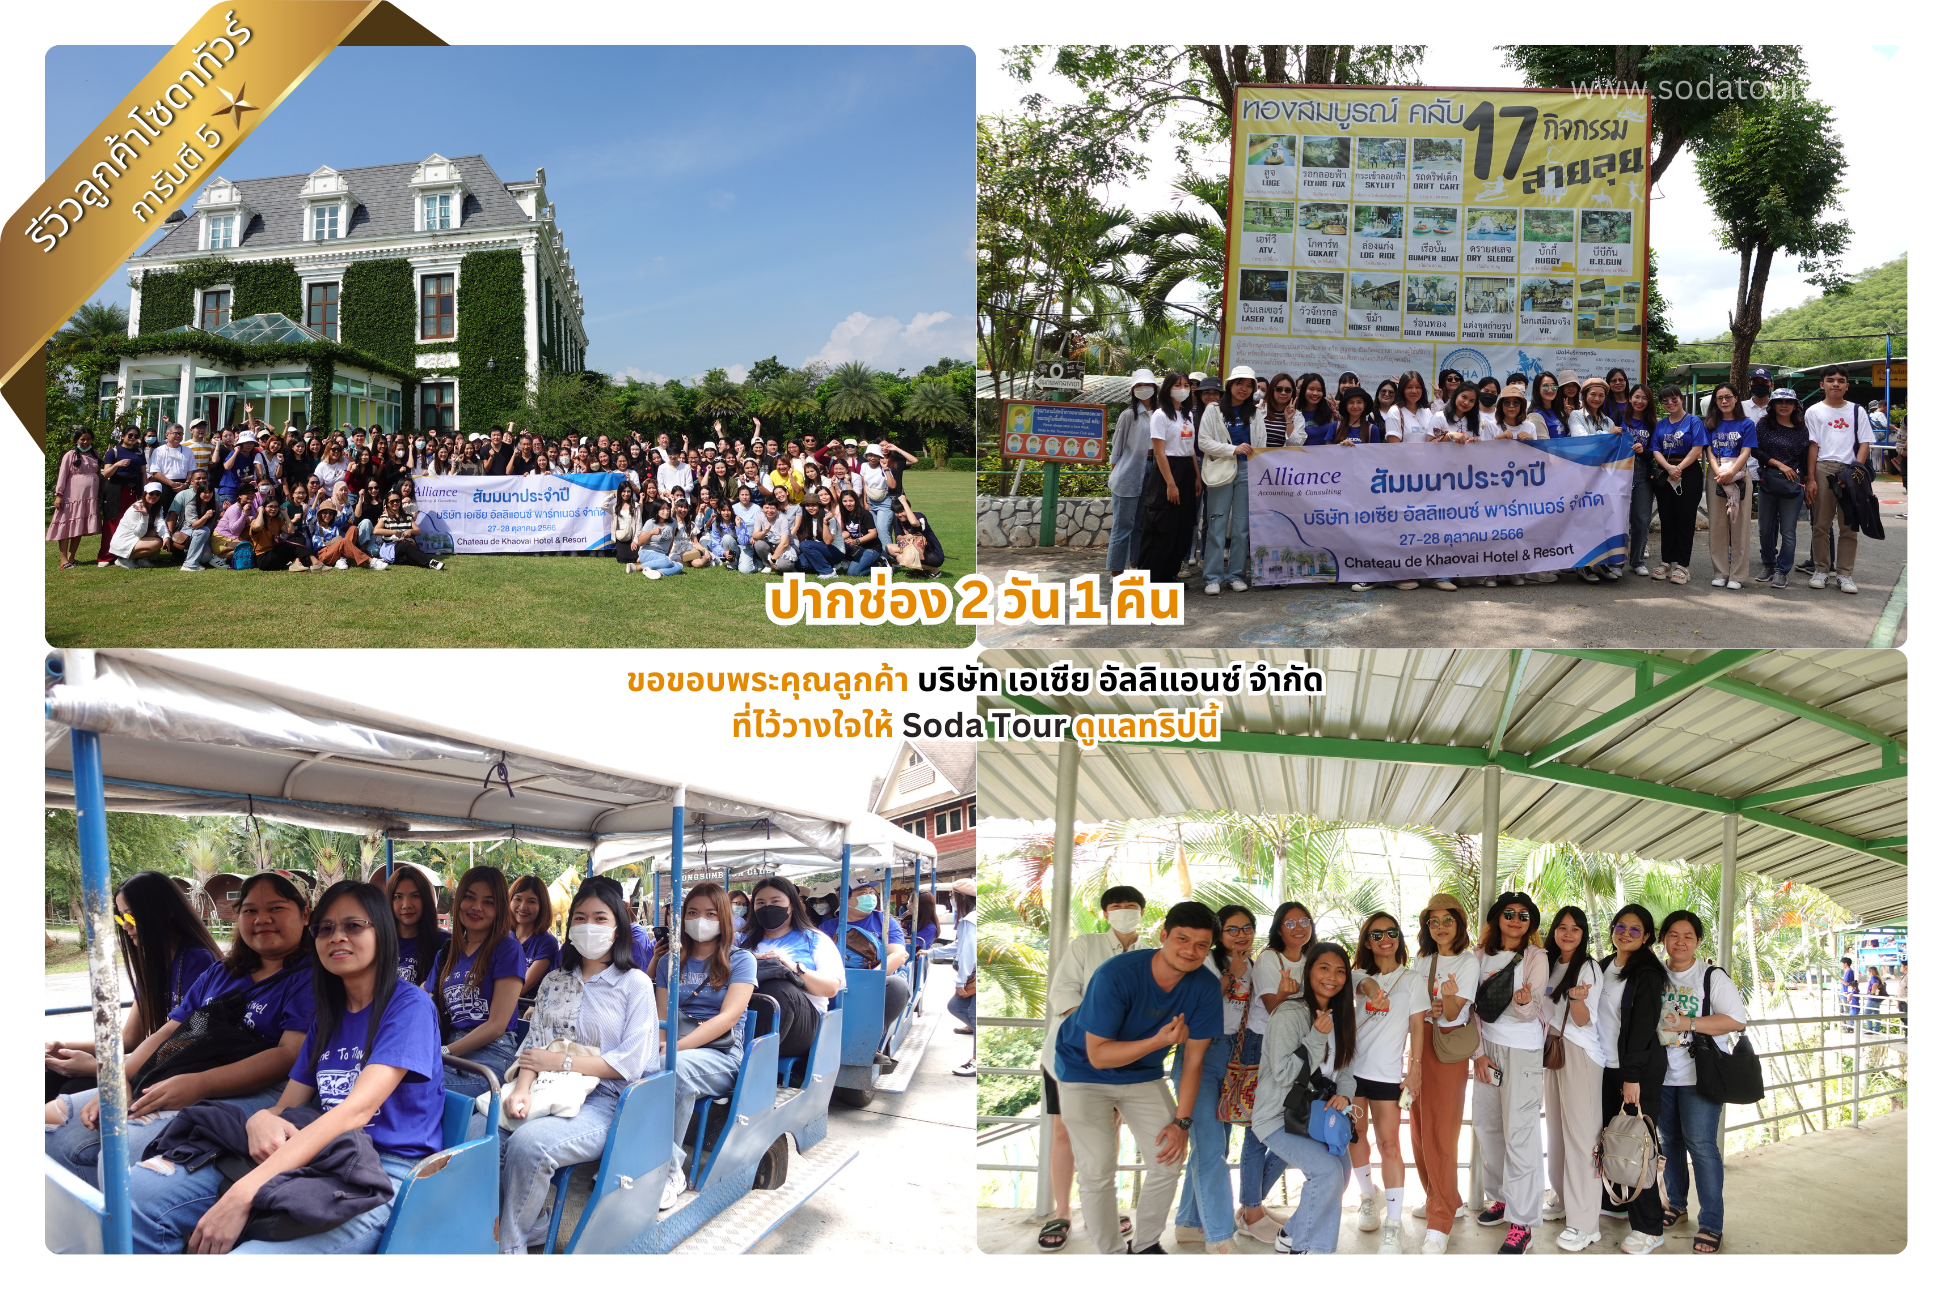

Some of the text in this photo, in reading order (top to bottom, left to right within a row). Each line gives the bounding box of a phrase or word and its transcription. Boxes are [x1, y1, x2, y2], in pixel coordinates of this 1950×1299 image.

[1241, 95, 1466, 130] ทองสมบูรณ์ คลับ
[1543, 113, 1629, 141] กิจกรรม
[1462, 100, 1539, 181] 17
[1521, 146, 1644, 196] สายลุย
[1262, 179, 1281, 187] LUGE
[1332, 180, 1346, 188] FOX
[1365, 181, 1395, 189] SKYLIFT
[1413, 182, 1434, 190] DRIFT
[1258, 246, 1276, 254] ATV.
[1308, 250, 1338, 258] GOKART
[1360, 251, 1396, 260] LOG RIDE
[1408, 254, 1437, 262] BUMPER
[1466, 254, 1515, 263] DRY SLEDGE
[1535, 257, 1561, 265] BUGGY
[1590, 258, 1622, 266] B.B.GUN
[1241, 315, 1284, 324] LASER TAG
[1306, 317, 1331, 325] RODEO
[1425, 330, 1456, 338] PANNING
[1456, 370, 1478, 378] HA
[1257, 467, 1341, 486] Alliance
[1371, 461, 1546, 494] สัมมนาประจำปี
[415, 486, 458, 497] Alliance
[473, 487, 570, 503] สัมมนาประจำปี
[1257, 490, 1294, 498] Accounting
[1305, 488, 1342, 497] Consulting
[437, 510, 461, 519] บริษัท
[490, 509, 532, 519] อัลลิแอนซ์
[535, 508, 580, 518] พาร์ทเนอร์
[583, 507, 606, 517] จำกัด
[1304, 491, 1604, 526] บริษัท เอเซีย อัลลิแอนซ์ พาร์ทเนอร์ จำกัด
[512, 525, 536, 534] ตุลาคม
[1399, 528, 1524, 547] 27-28 ตุลาคม 2566
[1344, 543, 1575, 569] Chateau de Khaovai Hotel & Resort
[337, 1047, 349, 1060] To
